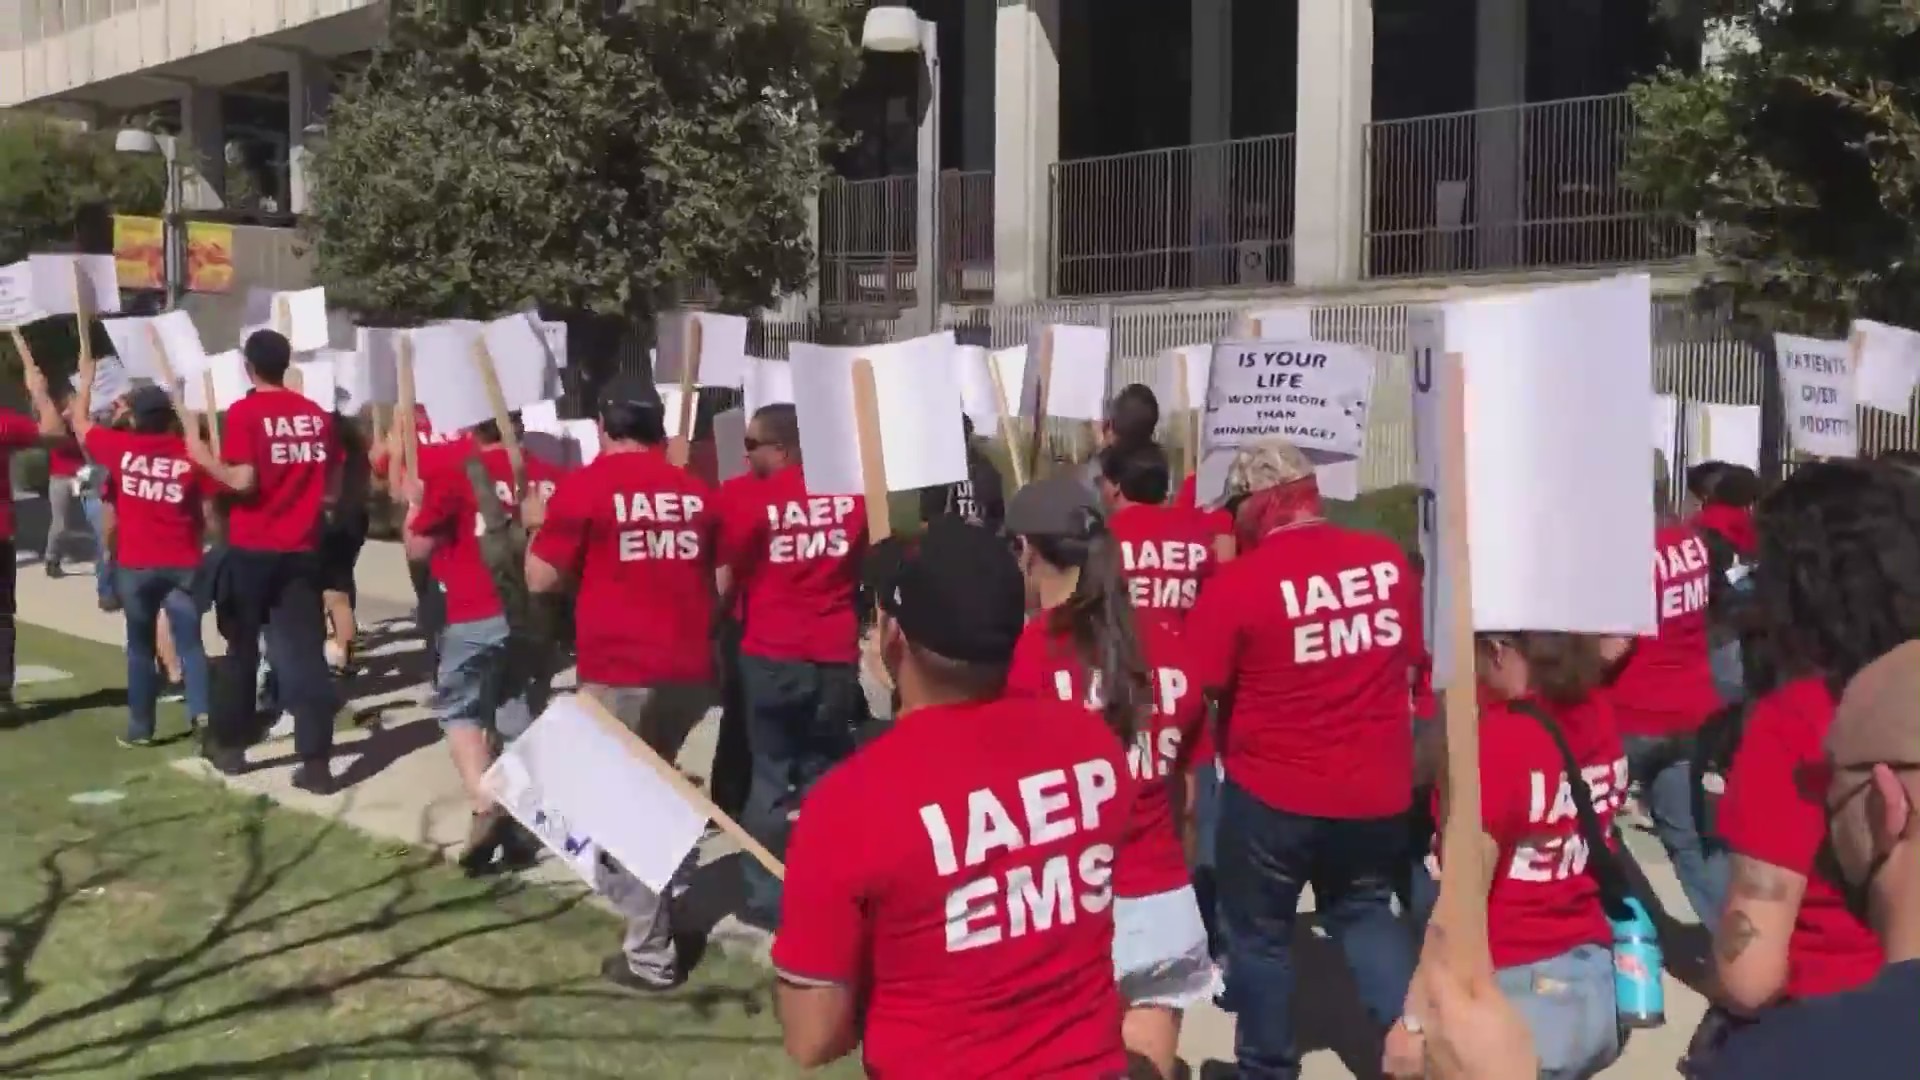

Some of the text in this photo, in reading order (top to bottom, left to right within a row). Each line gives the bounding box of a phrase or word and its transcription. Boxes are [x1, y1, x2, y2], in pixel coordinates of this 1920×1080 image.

[1238, 351, 1327, 368] IS YOUR
[1256, 373, 1303, 389] LIFE
[1801, 384, 1837, 405] OVER
[1228, 395, 1328, 407] WORTH MORE
[1256, 410, 1296, 418] THAN
[263, 415, 325, 438] IAEP
[1213, 425, 1336, 440] MINIMUM WAGE?
[120, 451, 191, 480] IAEP
[270, 442, 327, 464] EMS
[121, 475, 183, 504] EMS
[613, 492, 704, 523] IAEP
[766, 496, 856, 531] IAEP
[619, 530, 700, 562] EMS
[769, 528, 850, 563] EMS
[1120, 540, 1208, 571] IAEP
[1128, 577, 1199, 609] EMS
[1279, 561, 1400, 619] IAEP
[1662, 574, 1710, 618] EM
[1293, 608, 1403, 664] EMS
[919, 757, 1117, 877] IAEP
[945, 843, 1115, 953] EMS
